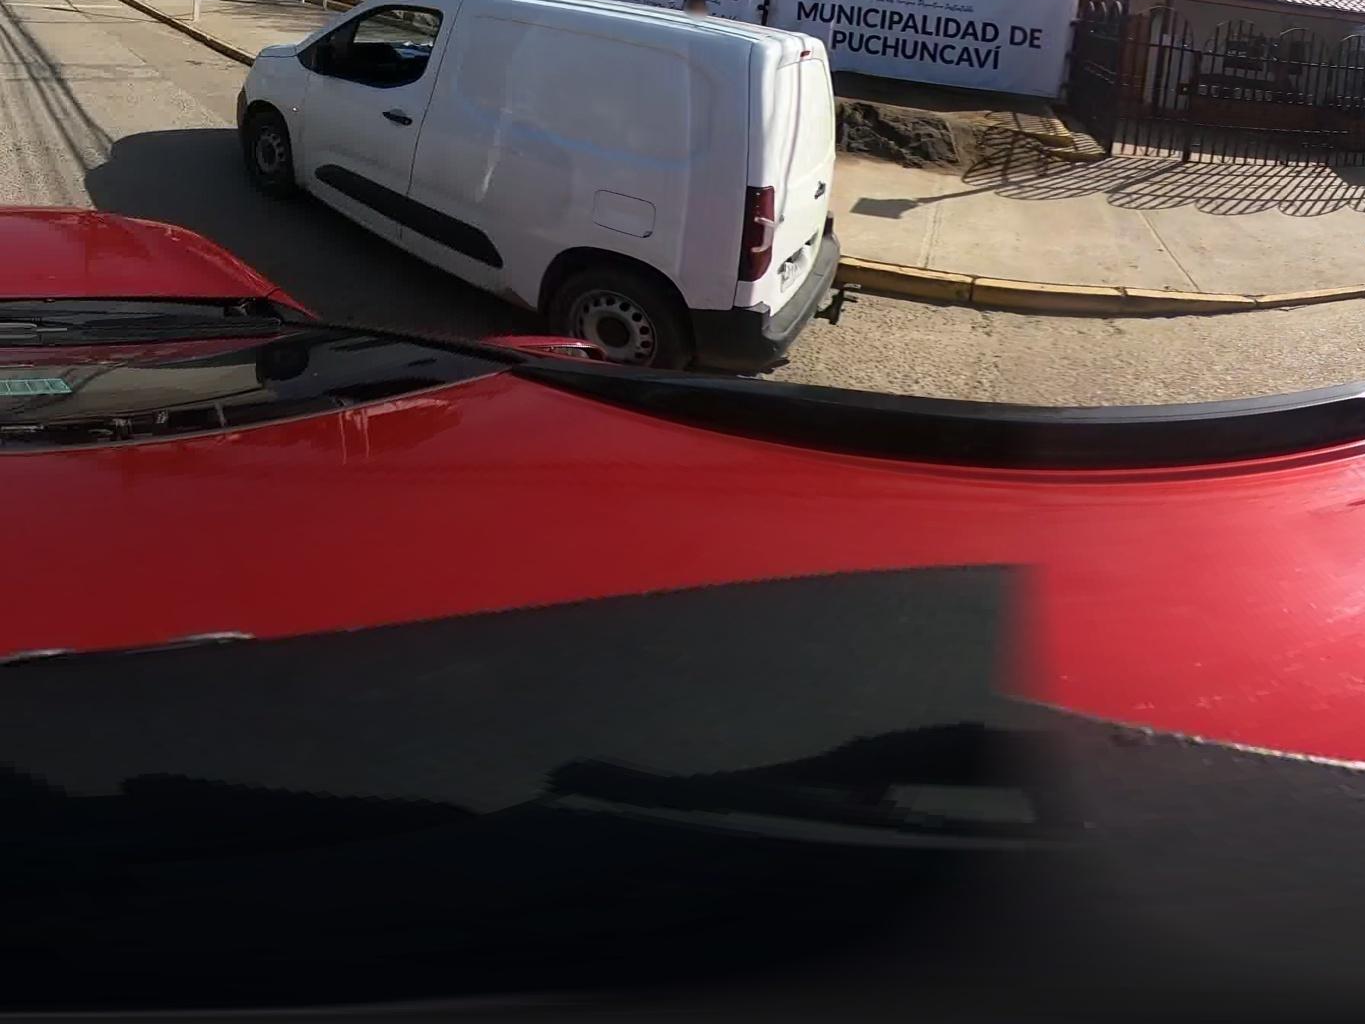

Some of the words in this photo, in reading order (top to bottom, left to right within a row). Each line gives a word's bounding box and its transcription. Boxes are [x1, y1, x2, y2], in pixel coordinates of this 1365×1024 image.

[796, 0, 1000, 44] MUNICIPALIDAD
[1009, 25, 1043, 49] DE
[830, 29, 1003, 71] PUCHUNCAVÍ
